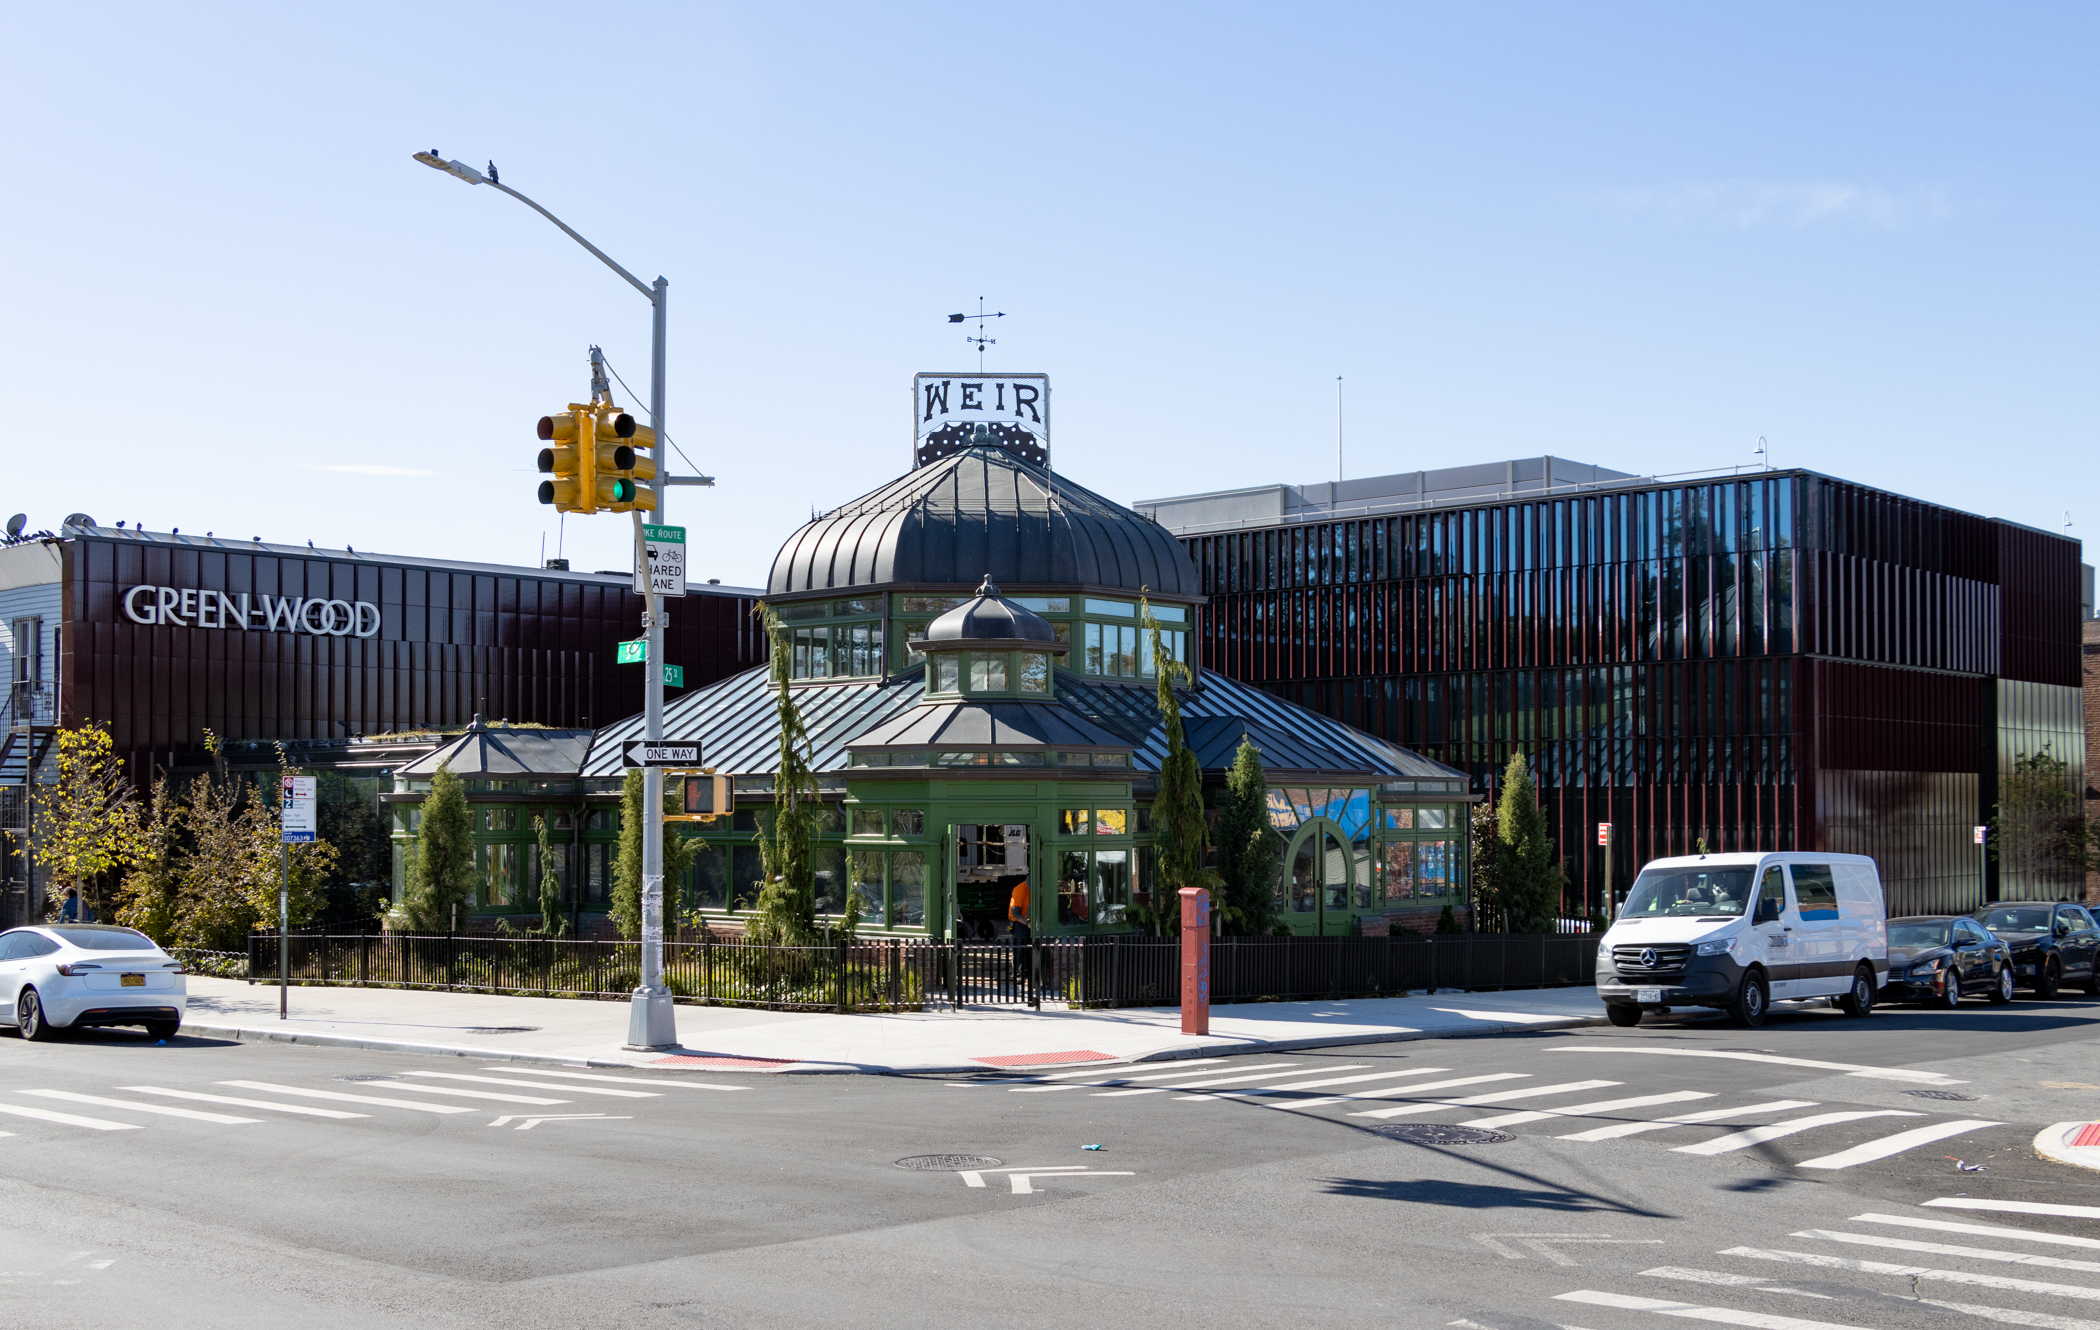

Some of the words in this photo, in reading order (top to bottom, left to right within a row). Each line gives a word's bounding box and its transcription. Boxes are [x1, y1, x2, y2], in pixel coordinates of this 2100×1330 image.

[923, 380, 1041, 424] WEIR
[643, 529, 655, 538] IKE
[658, 529, 682, 540] ROUTE
[653, 578, 674, 590] ANE
[124, 584, 381, 638] GREEN-WOOD
[665, 667, 673, 682] 25
[646, 748, 668, 759] ONE
[672, 748, 694, 759] WAY
[286, 799, 291, 808] 2
